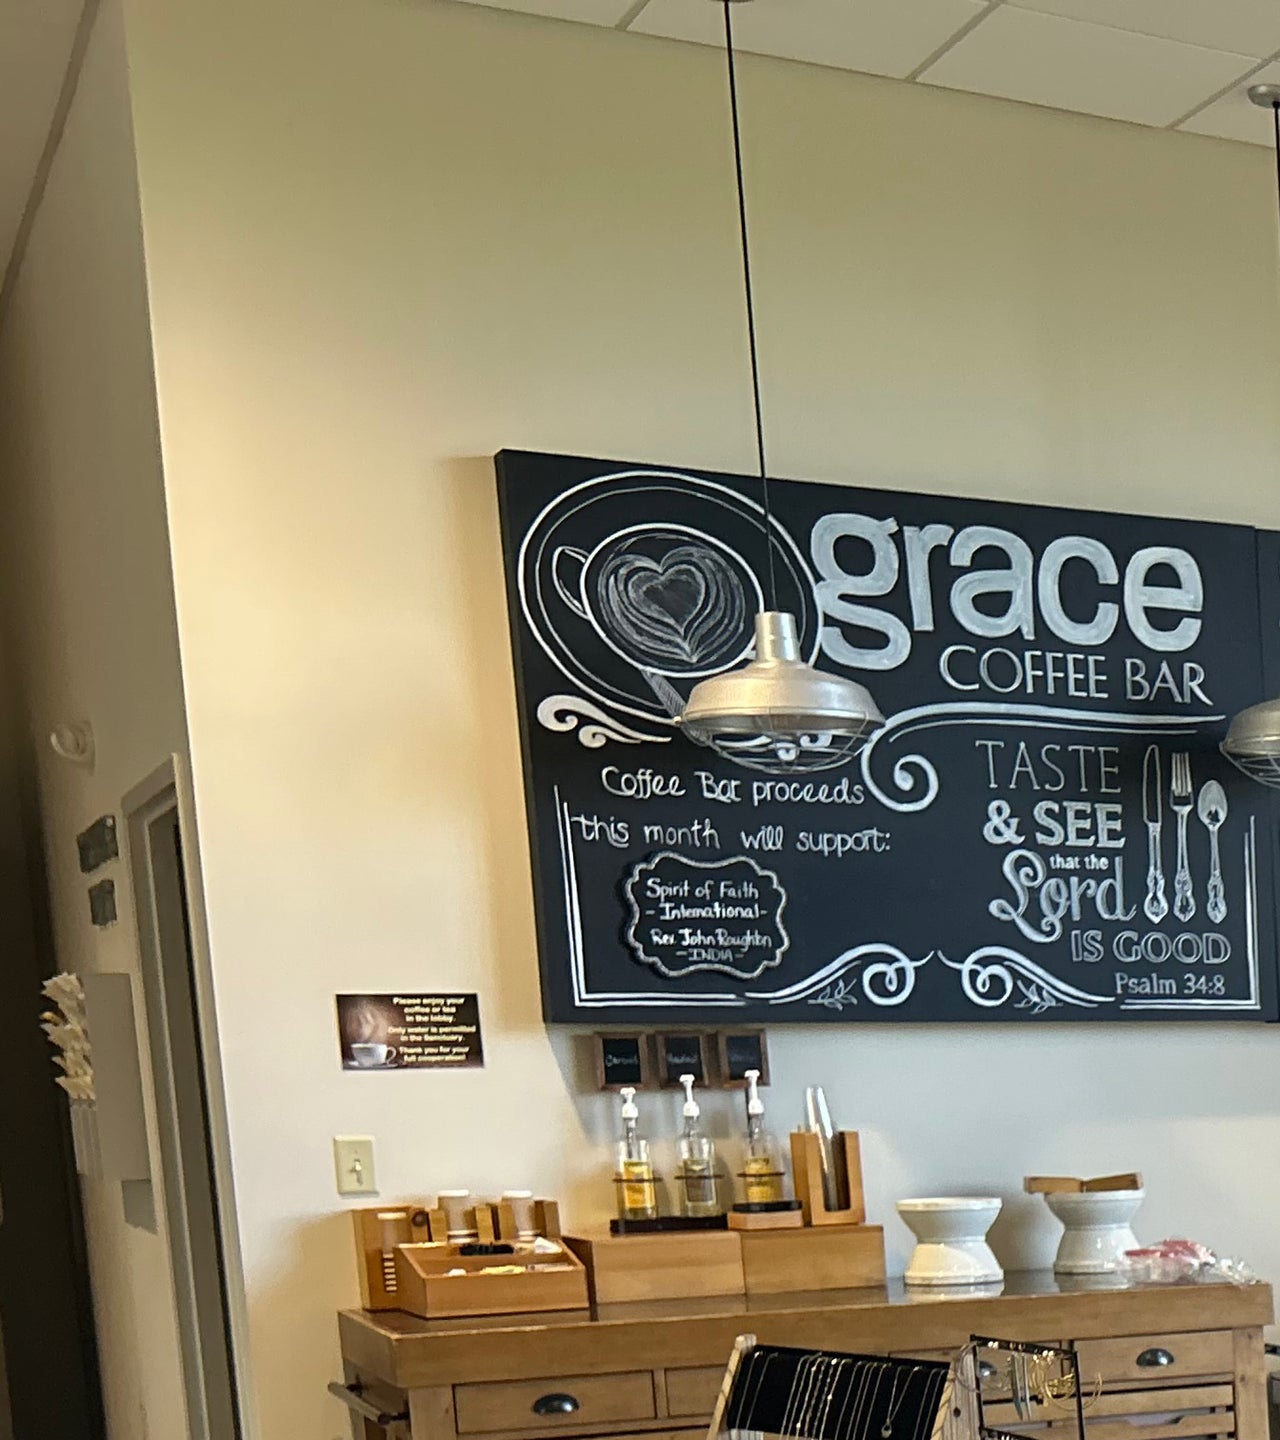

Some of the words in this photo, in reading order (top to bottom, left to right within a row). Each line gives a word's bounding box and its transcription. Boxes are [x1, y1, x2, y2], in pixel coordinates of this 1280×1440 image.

[811, 512, 1203, 670] grace
[939, 646, 1109, 699] COFFEE
[1125, 658, 1214, 706] BAR
[602, 766, 686, 798] Coffee
[695, 771, 741, 803] Bar
[753, 777, 865, 806] proceeds
[975, 740, 1122, 793] TASTE
[571, 814, 629, 848] this
[644, 818, 720, 849] month
[740, 825, 784, 851] will
[796, 829, 890, 857] support:
[983, 799, 1025, 845] &
[1033, 800, 1126, 848] SEE
[1050, 854, 1080, 870] that
[1084, 854, 1109, 870] the
[645, 878, 690, 901] Spirit
[695, 880, 713, 899] of
[719, 882, 759, 899] Faith
[988, 849, 1137, 943] Lord
[680, 929, 716, 946] John
[1070, 930, 1104, 962] IS
[1113, 931, 1231, 964] GOOD
[1114, 973, 1176, 995] Psalm
[1184, 974, 1225, 995] 34:8
